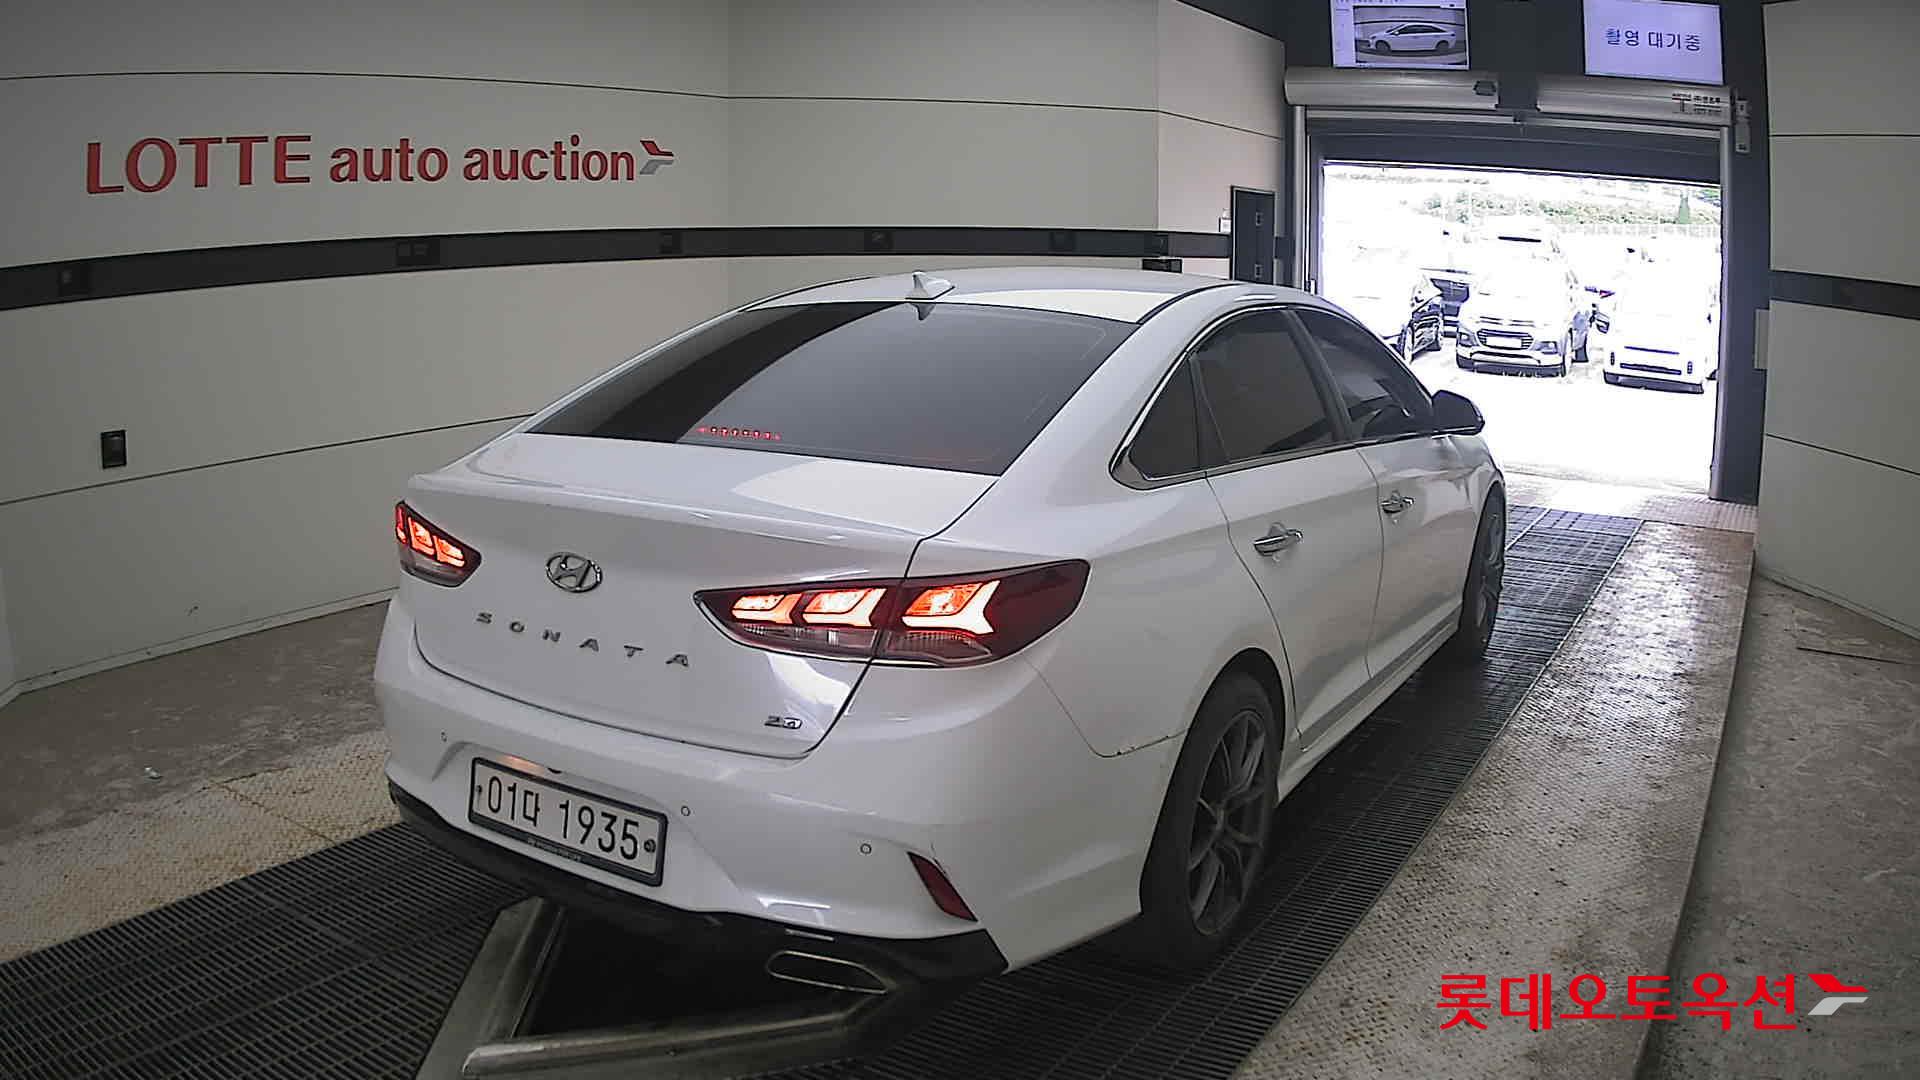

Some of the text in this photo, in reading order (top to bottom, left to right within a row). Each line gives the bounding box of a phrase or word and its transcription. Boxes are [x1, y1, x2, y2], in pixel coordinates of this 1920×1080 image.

[86, 135, 635, 194] LOTTE auto auction
[476, 611, 689, 668] SONATA
[559, 800, 641, 860] 1935
